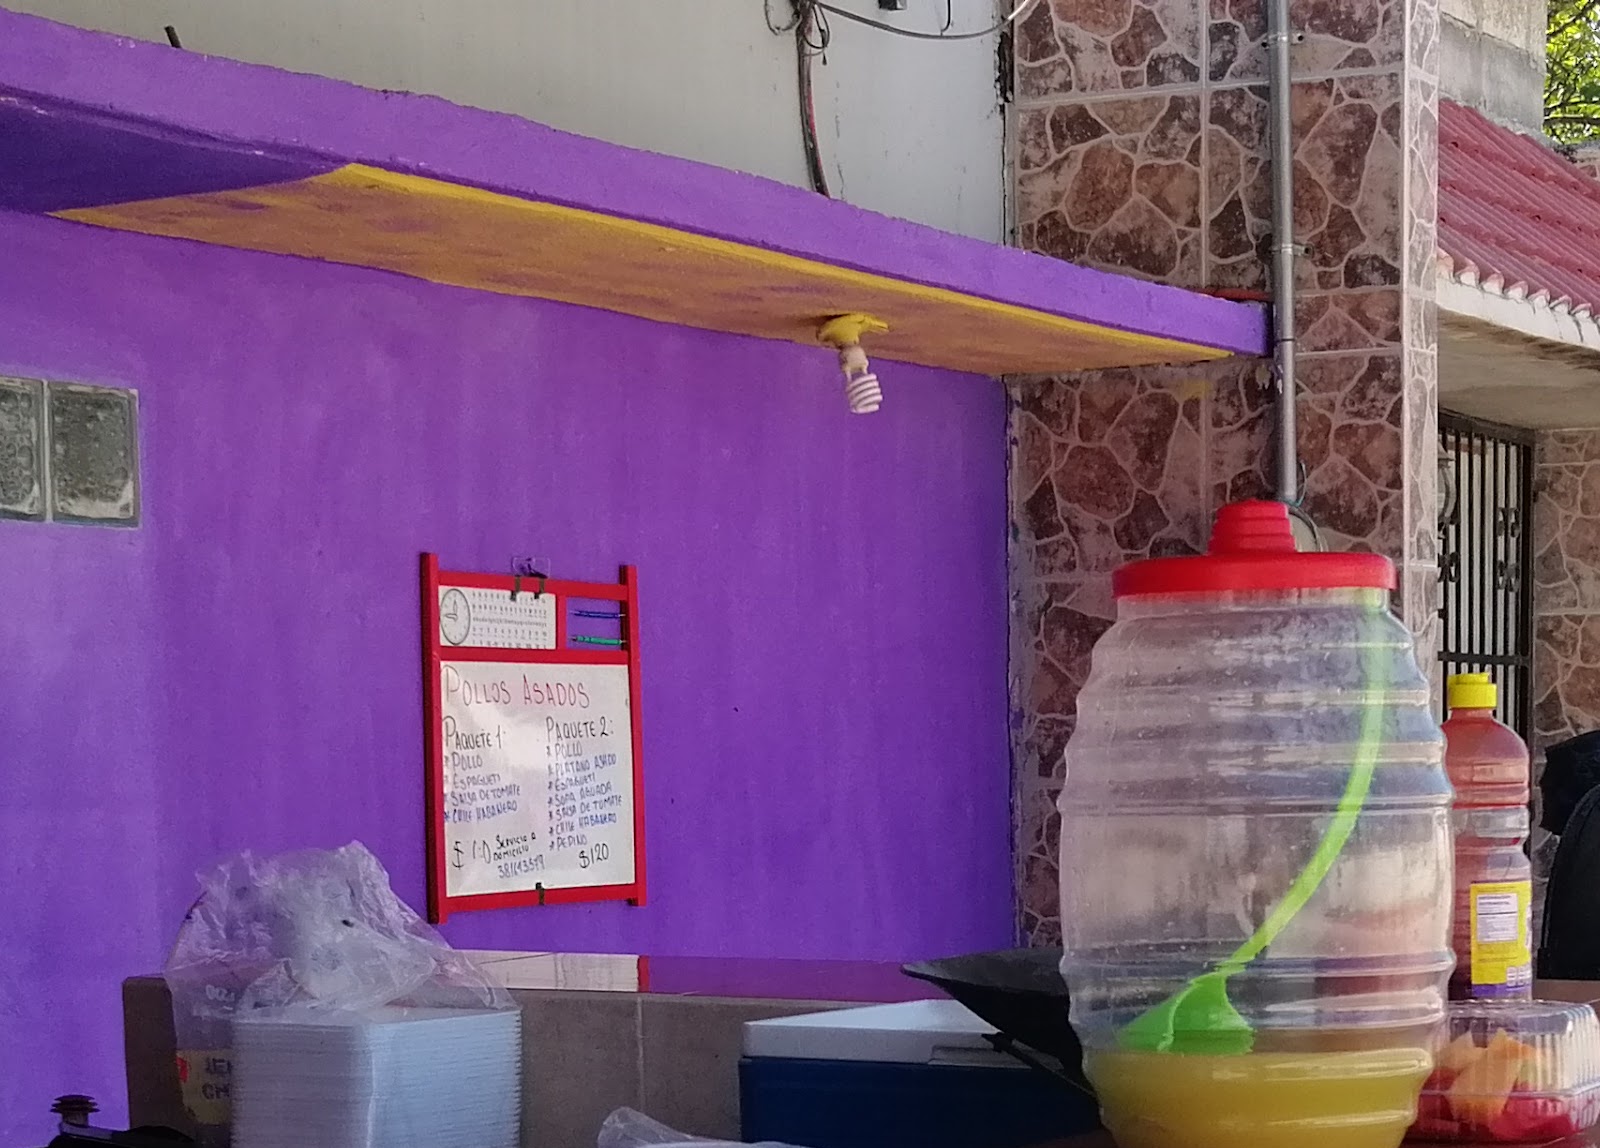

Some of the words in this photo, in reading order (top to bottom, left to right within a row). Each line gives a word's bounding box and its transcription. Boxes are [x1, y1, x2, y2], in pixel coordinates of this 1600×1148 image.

[441, 664, 512, 706] POLLOS
[523, 673, 590, 709] ASADOS
[443, 716, 493, 751] PAQUETE
[546, 716, 596, 742] PAQUETE
[452, 752, 483, 772] POLLO
[554, 741, 583, 760] POLLO
[578, 843, 610, 869] $120
